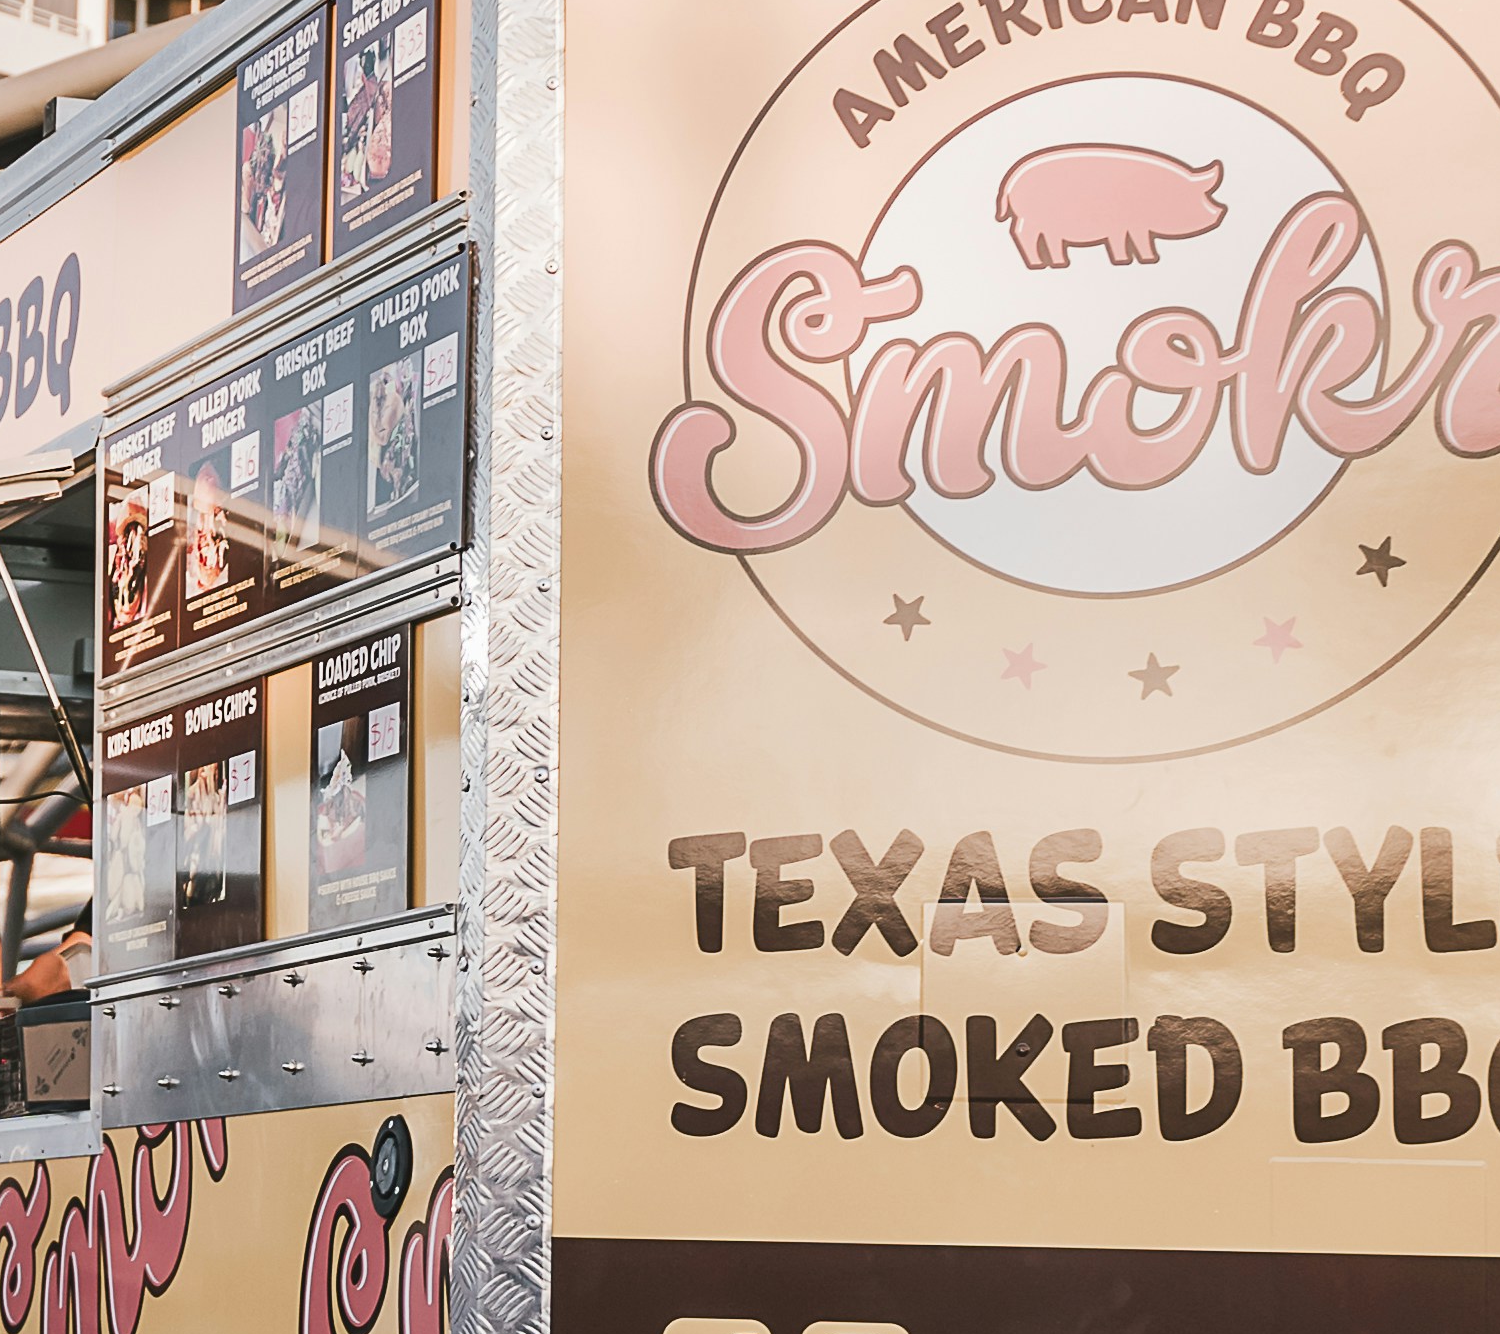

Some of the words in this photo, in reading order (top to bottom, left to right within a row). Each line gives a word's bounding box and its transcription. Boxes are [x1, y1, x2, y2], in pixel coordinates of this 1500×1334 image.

[342, 3, 380, 48] SPARE
[243, 36, 294, 91] MONSTER
[295, 18, 319, 55] BOX
[371, 284, 420, 332] PULLED
[421, 263, 460, 307] PORK
[275, 333, 325, 380] BRISKET
[325, 318, 355, 355] BEEF
[400, 310, 428, 348] BOX
[188, 385, 229, 427] PULLED
[229, 368, 261, 407] PORK
[302, 361, 326, 396] BOX
[109, 423, 150, 467] BRISKET
[151, 412, 176, 445] BEEF
[201, 405, 246, 448] BURGER
[122, 446, 161, 485] BURGER
[318, 646, 368, 689] LOADED
[370, 633, 401, 670] CHIP
[107, 730, 130, 759] KIDS
[131, 714, 173, 751] NUGGETS
[185, 699, 222, 736] BOWLS
[224, 687, 257, 722] CHIPS
[371, 713, 395, 759] $15
[668, 826, 1110, 958] TEXAS
[669, 1013, 1245, 1142] SMOKED
